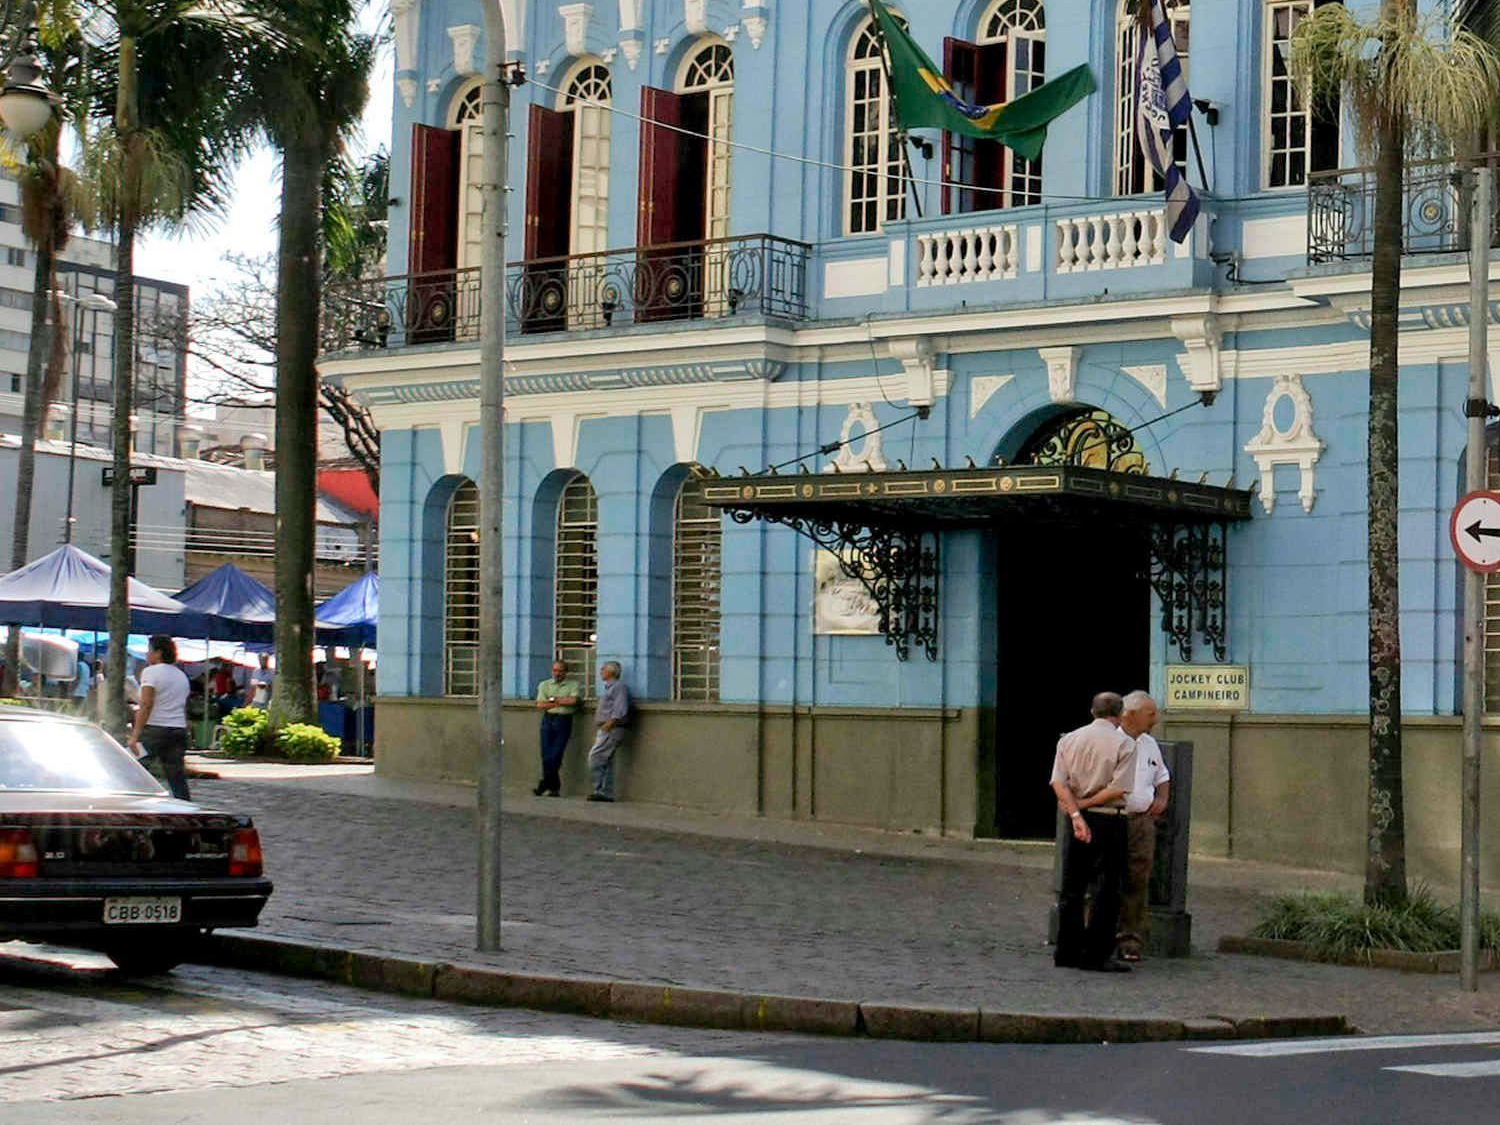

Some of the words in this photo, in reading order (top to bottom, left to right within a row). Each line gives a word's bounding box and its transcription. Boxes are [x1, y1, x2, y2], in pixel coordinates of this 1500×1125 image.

[1170, 674, 1211, 684] JOCKEY
[1217, 674, 1244, 684] CLUB
[1174, 690, 1240, 700] CAMPINEIRO
[109, 906, 140, 919] CBB
